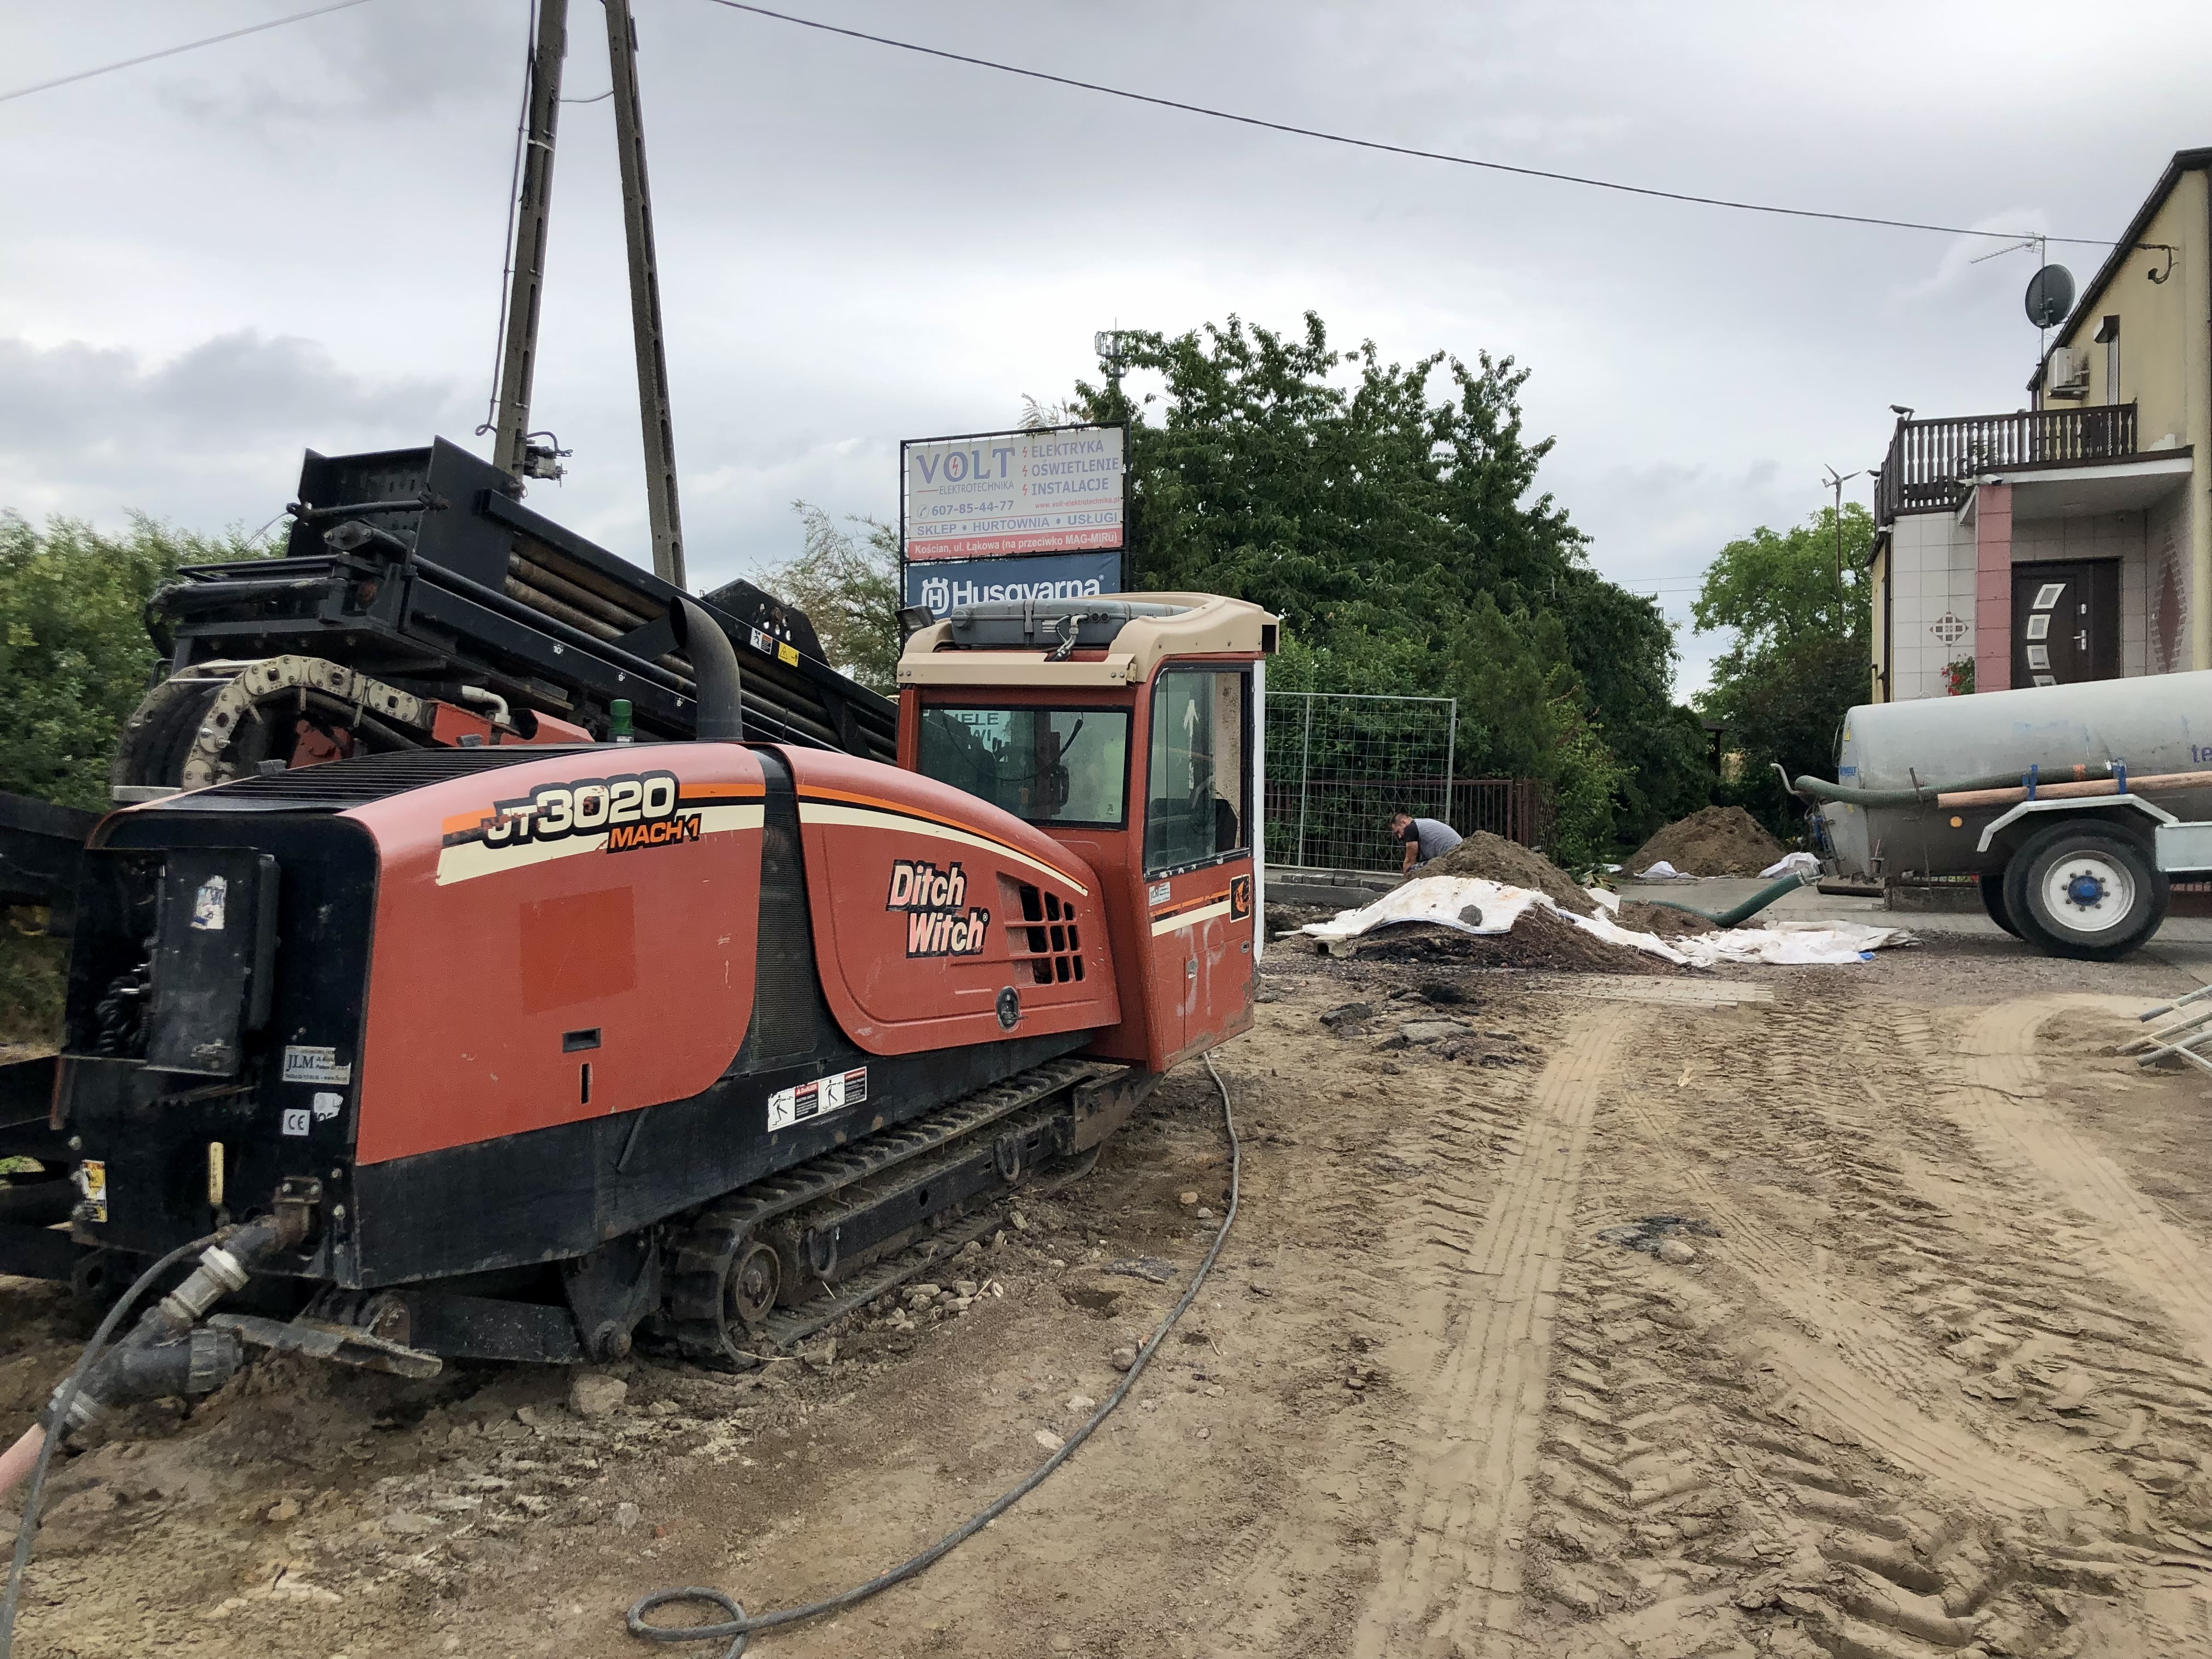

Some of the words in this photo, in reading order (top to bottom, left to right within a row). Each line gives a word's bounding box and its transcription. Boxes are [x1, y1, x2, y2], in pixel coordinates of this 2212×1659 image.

[1031, 439, 1104, 458] ELEKTRYKA
[916, 447, 1015, 484] VOLT
[1031, 458, 1119, 477] OŚWIETLENIE
[939, 481, 1014, 495] ELEKTROTECHNIKA
[1031, 477, 1109, 496] INSTALACJE
[932, 500, 1014, 516] 607-85-44-77
[917, 523, 957, 536] SKLEP
[973, 517, 1050, 532] HURTOWNIA
[1068, 512, 1117, 526] USŁUGI
[915, 544, 951, 554] Kościan,
[953, 541, 964, 552] ul.
[966, 540, 1000, 554] Łąkowa
[1002, 539, 1015, 551] (na
[1018, 535, 1063, 550] przeciwko
[1065, 531, 1118, 545] MAG-MIRu)
[953, 579, 1100, 606] Husqvarna
[487, 776, 675, 841] JT3020
[610, 820, 682, 849] MACH
[688, 817, 699, 837] 1
[889, 865, 965, 906] Ditch
[909, 912, 984, 953] Witch
[286, 1054, 315, 1072] JLM
[288, 1114, 306, 1131] CE
